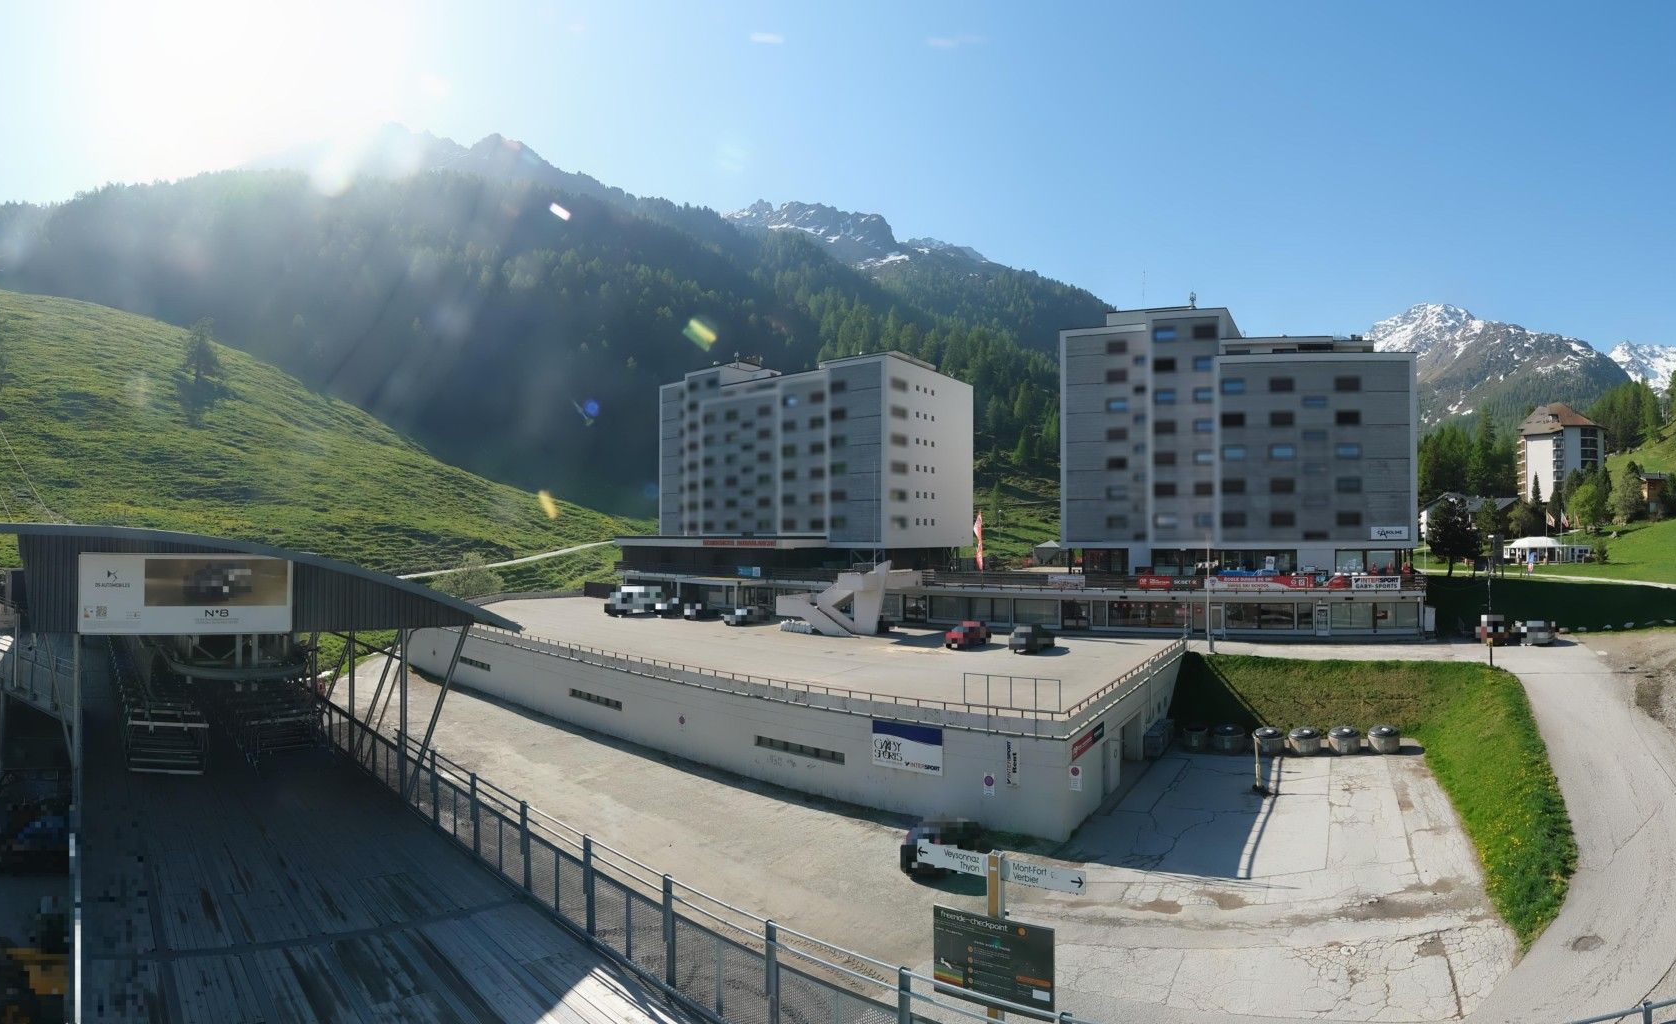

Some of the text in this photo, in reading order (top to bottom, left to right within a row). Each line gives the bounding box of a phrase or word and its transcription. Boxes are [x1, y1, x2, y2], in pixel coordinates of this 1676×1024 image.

[910, 762, 941, 772] INTERSPORT
[944, 849, 980, 864] Veysonnaz
[960, 861, 980, 873] Thyon
[1012, 863, 1047, 877] Mont-Fort
[1013, 872, 1040, 884] Verbier
